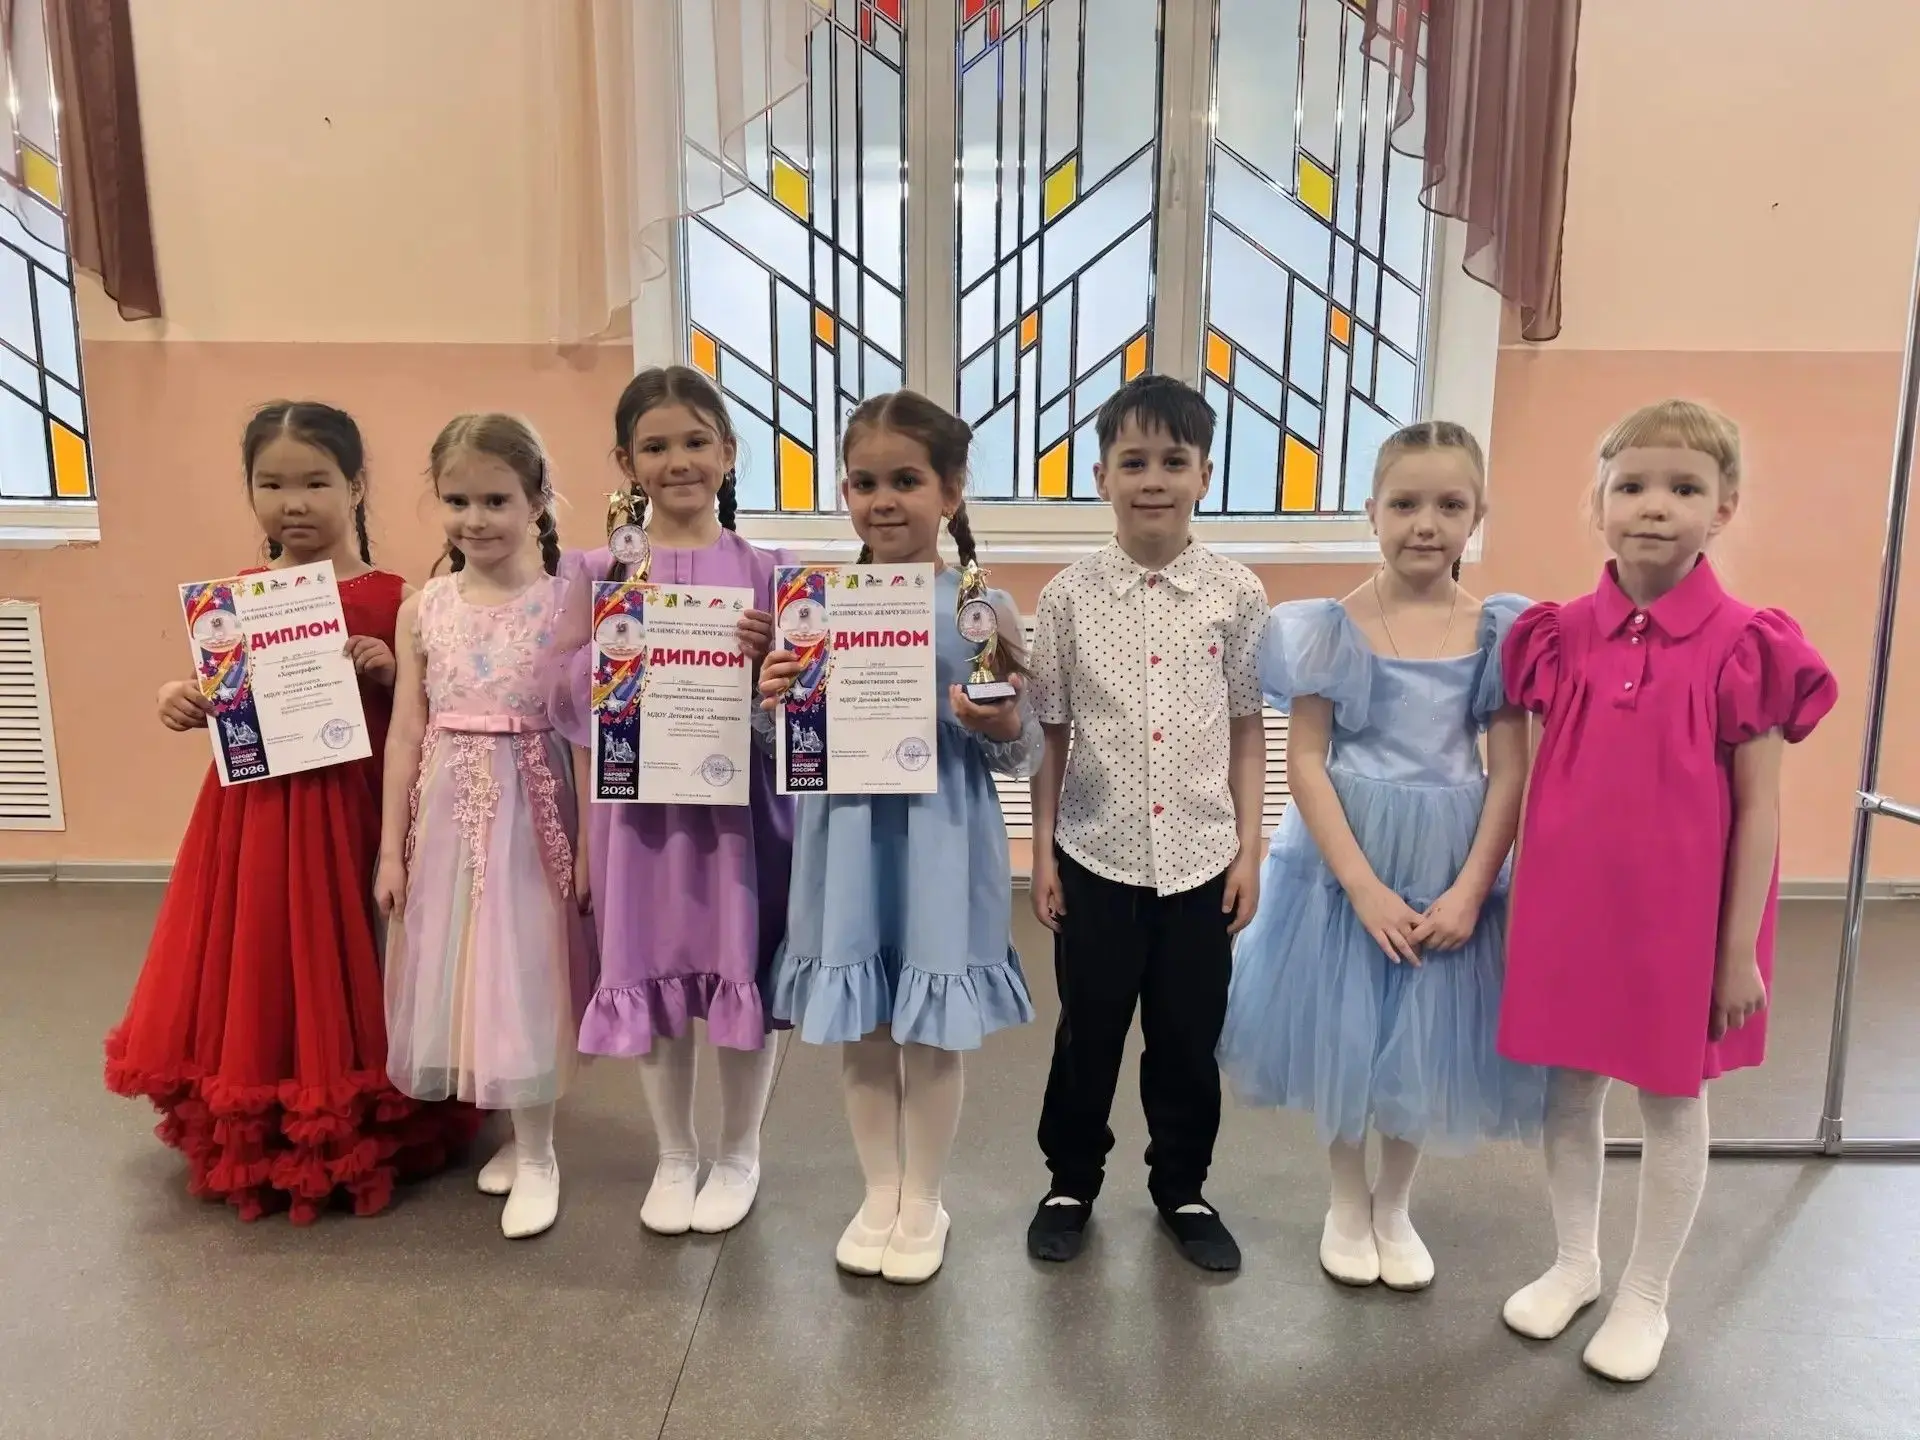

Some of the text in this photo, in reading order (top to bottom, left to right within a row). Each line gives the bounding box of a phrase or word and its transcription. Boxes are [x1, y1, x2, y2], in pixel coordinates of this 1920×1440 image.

[251, 618, 340, 651] ДИПЛОМ
[834, 630, 929, 651] ДИПЛОМ
[650, 648, 744, 668] ДИПЛОМ
[230, 752, 257, 761] НАРОДОВ
[231, 764, 265, 777] 2026
[790, 777, 824, 787] 2026
[600, 785, 635, 796] 2026
